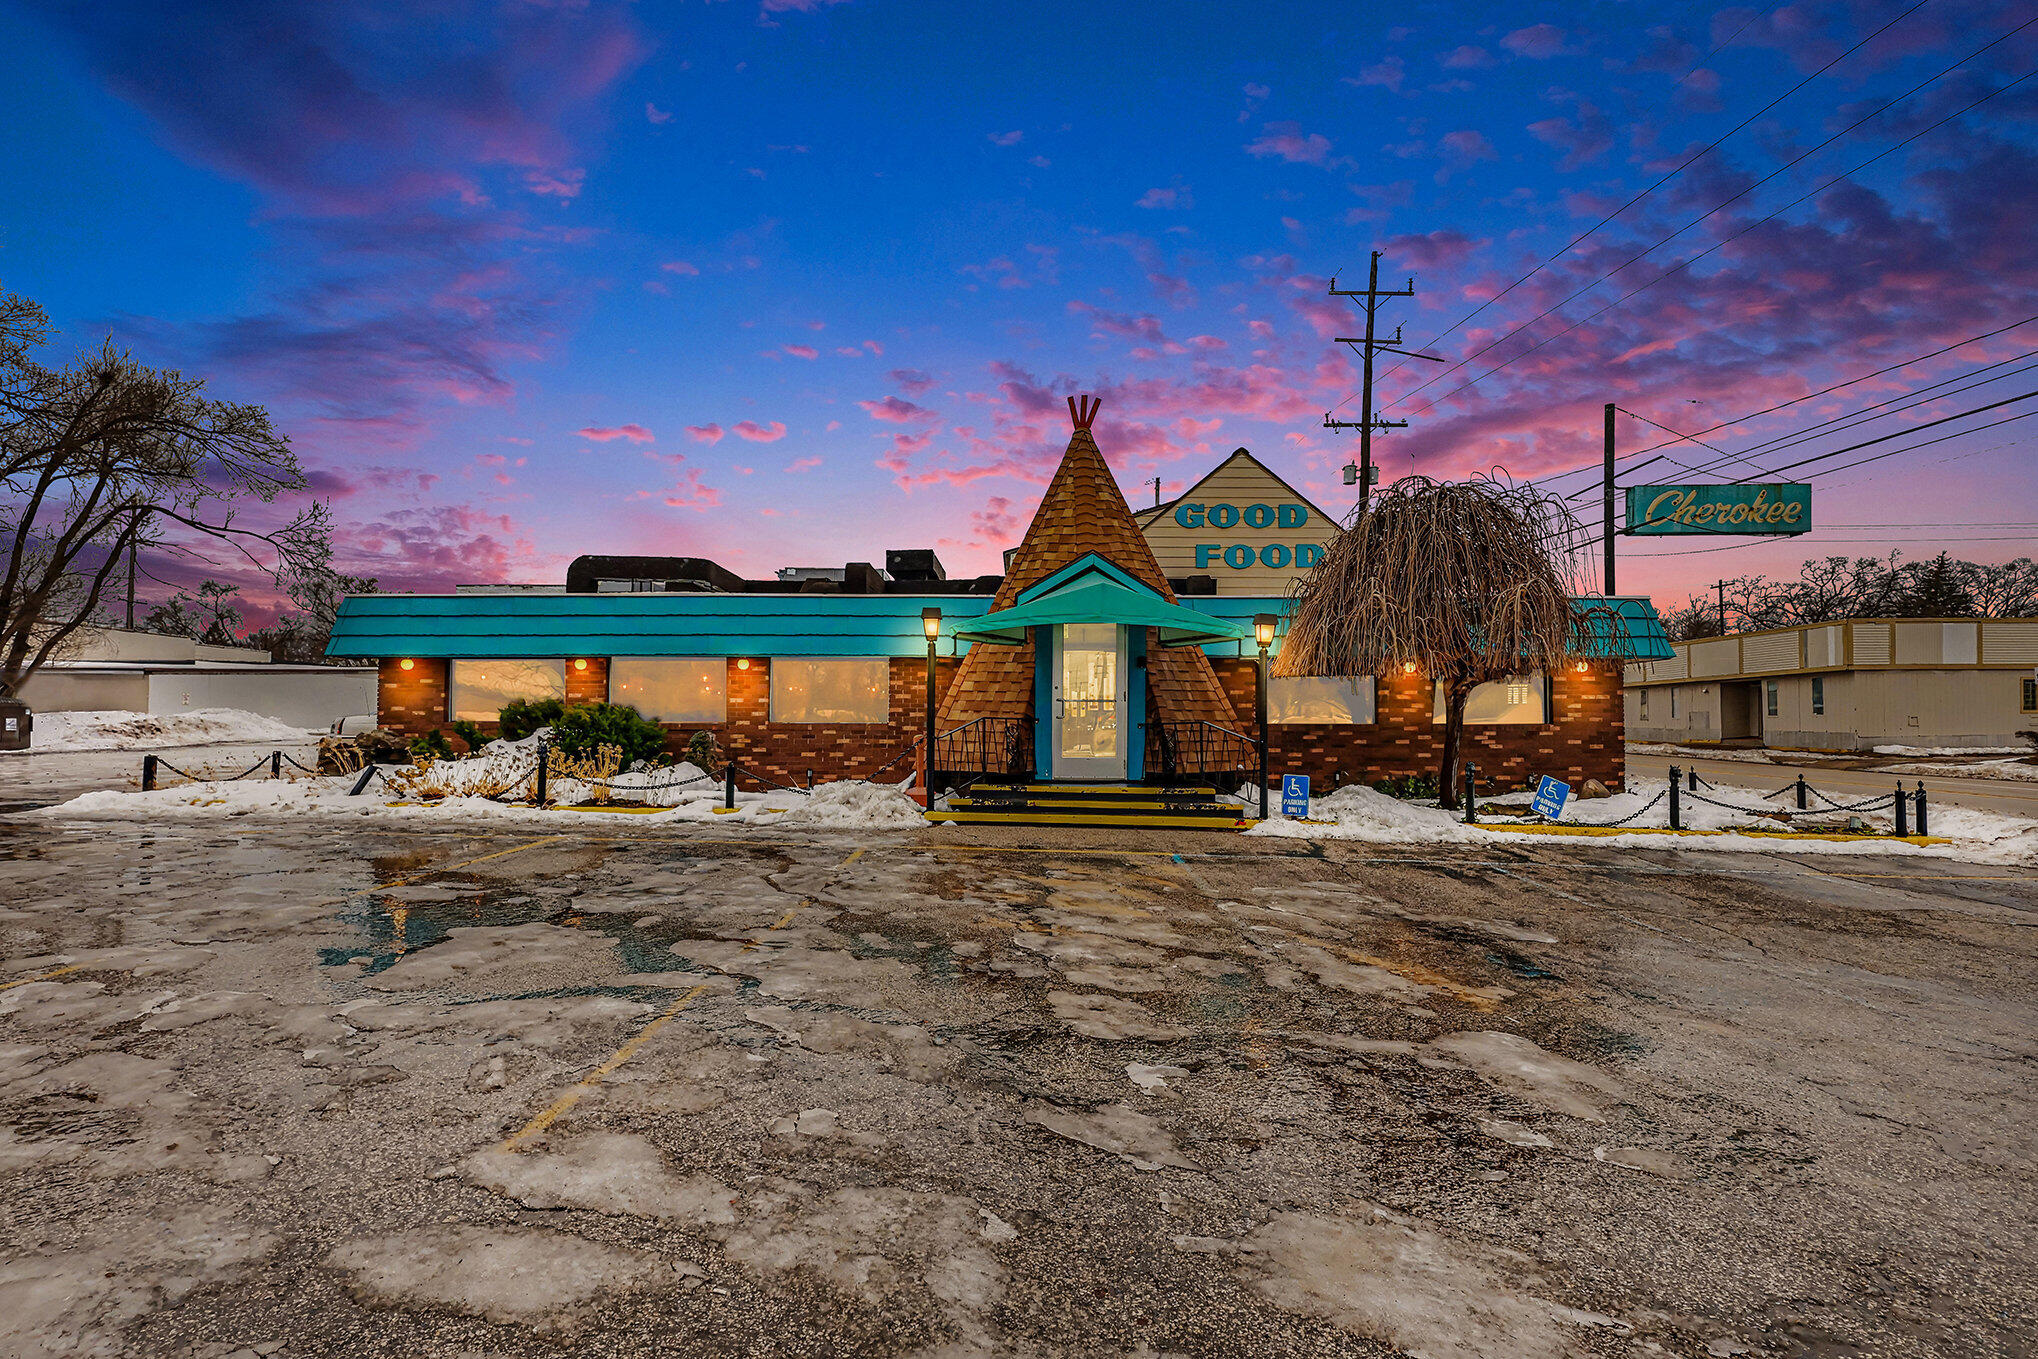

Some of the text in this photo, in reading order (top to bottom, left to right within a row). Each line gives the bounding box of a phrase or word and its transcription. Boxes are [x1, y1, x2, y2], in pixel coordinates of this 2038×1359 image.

[1174, 503, 1309, 529] GOOD
[1645, 489, 1803, 527] Cherokee
[1195, 543, 1326, 570] FOOD
[1536, 796, 1561, 810] PARKING
[1538, 804, 1554, 814] ONLY
